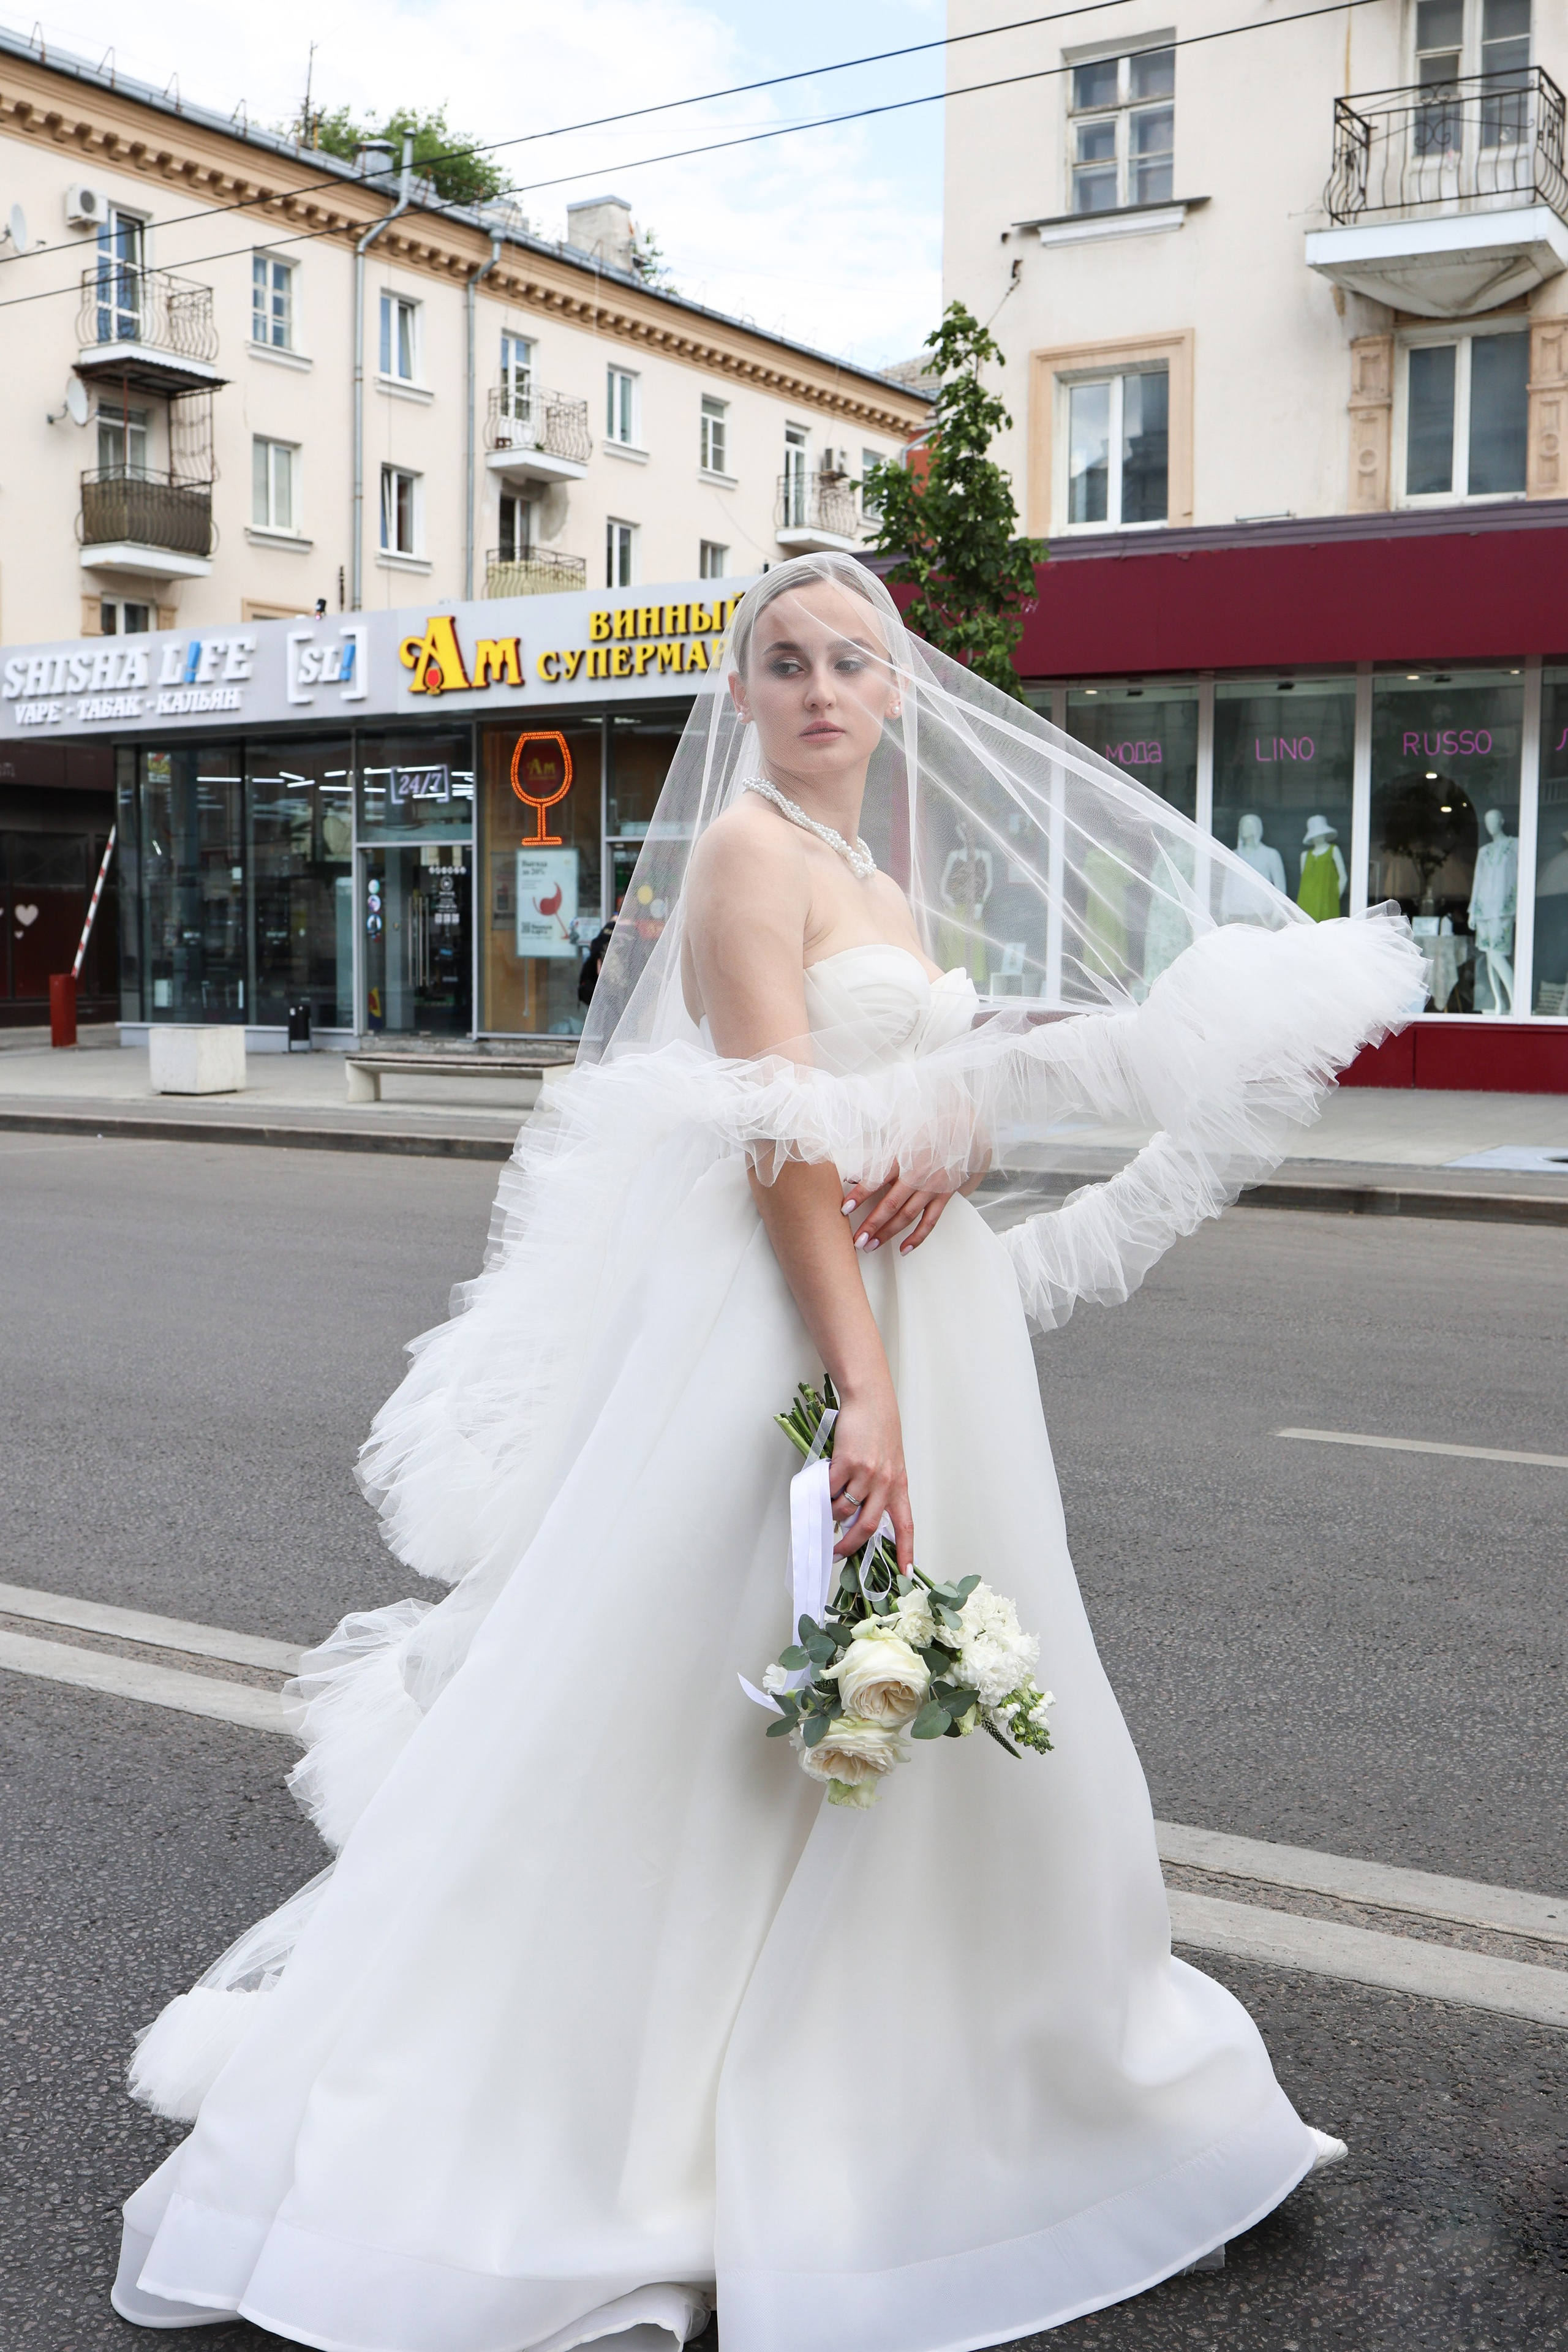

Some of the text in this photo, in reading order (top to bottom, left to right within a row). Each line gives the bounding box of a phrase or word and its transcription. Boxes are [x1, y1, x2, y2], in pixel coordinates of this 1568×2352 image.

[2, 647, 149, 699] SHISHA
[399, 616, 524, 695] Ам
[537, 638, 727, 682] СУПЕРМАР
[15, 701, 62, 725] VAPE
[77, 696, 142, 720] ТАБАК
[156, 687, 243, 714] КАЛЬЯН
[1255, 736, 1315, 761] LINO
[1403, 729, 1493, 756] RUSSO
[398, 772, 442, 795] 24/7
